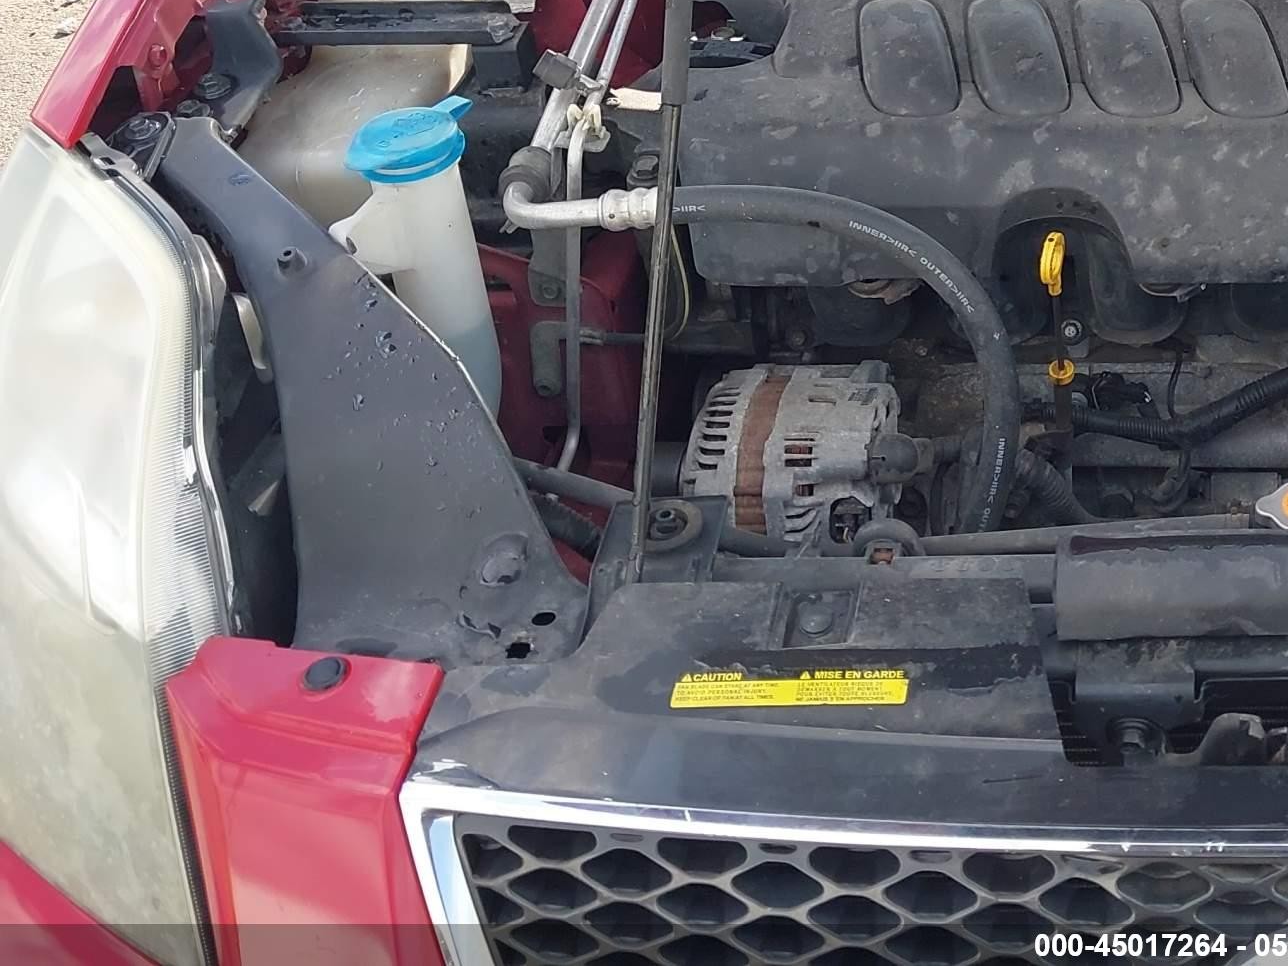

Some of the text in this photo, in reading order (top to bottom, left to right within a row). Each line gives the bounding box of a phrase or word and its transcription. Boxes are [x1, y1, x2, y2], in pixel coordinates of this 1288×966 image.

[693, 672, 742, 682] CAUTION
[814, 670, 905, 679] MISE EN GARDE
